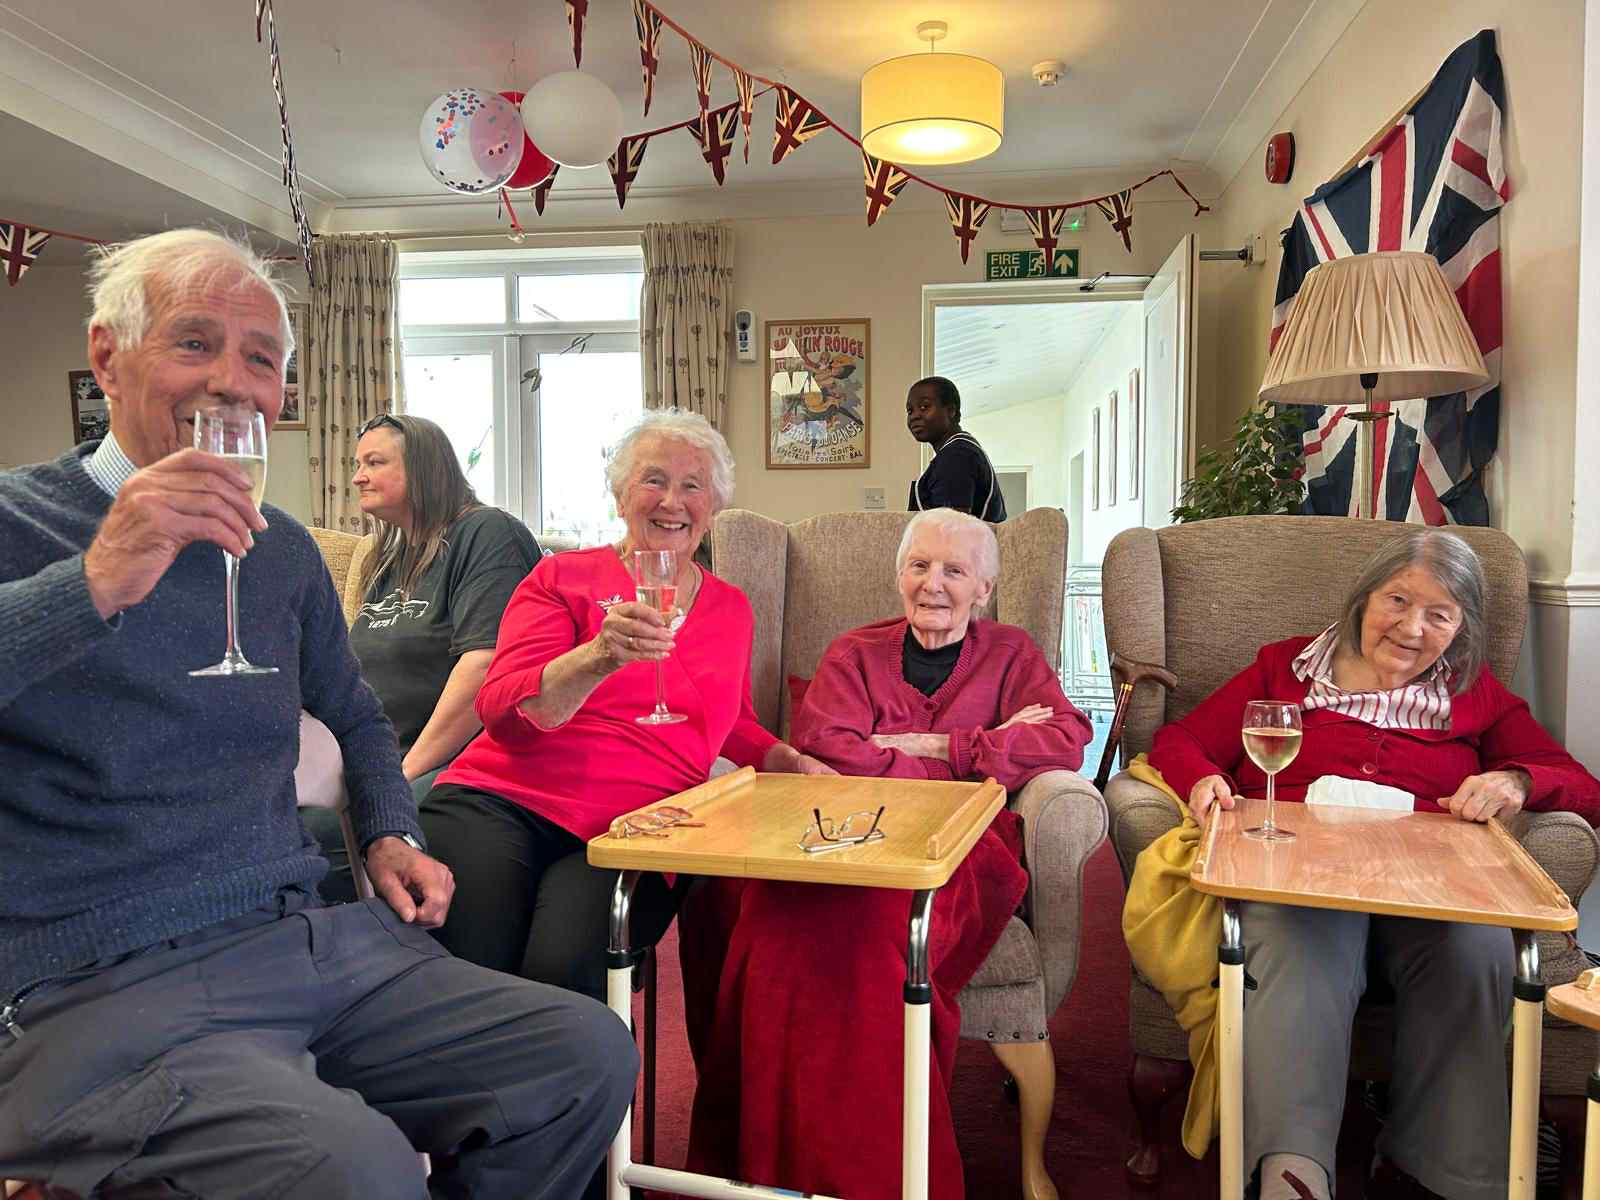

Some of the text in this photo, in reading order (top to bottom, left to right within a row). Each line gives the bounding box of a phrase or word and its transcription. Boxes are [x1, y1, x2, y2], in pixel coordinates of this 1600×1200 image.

[992, 253, 1020, 265] FIRE
[991, 266, 1020, 278] EXIT
[778, 326, 841, 337] AU JOYEUX
[824, 335, 865, 359] ROUGE
